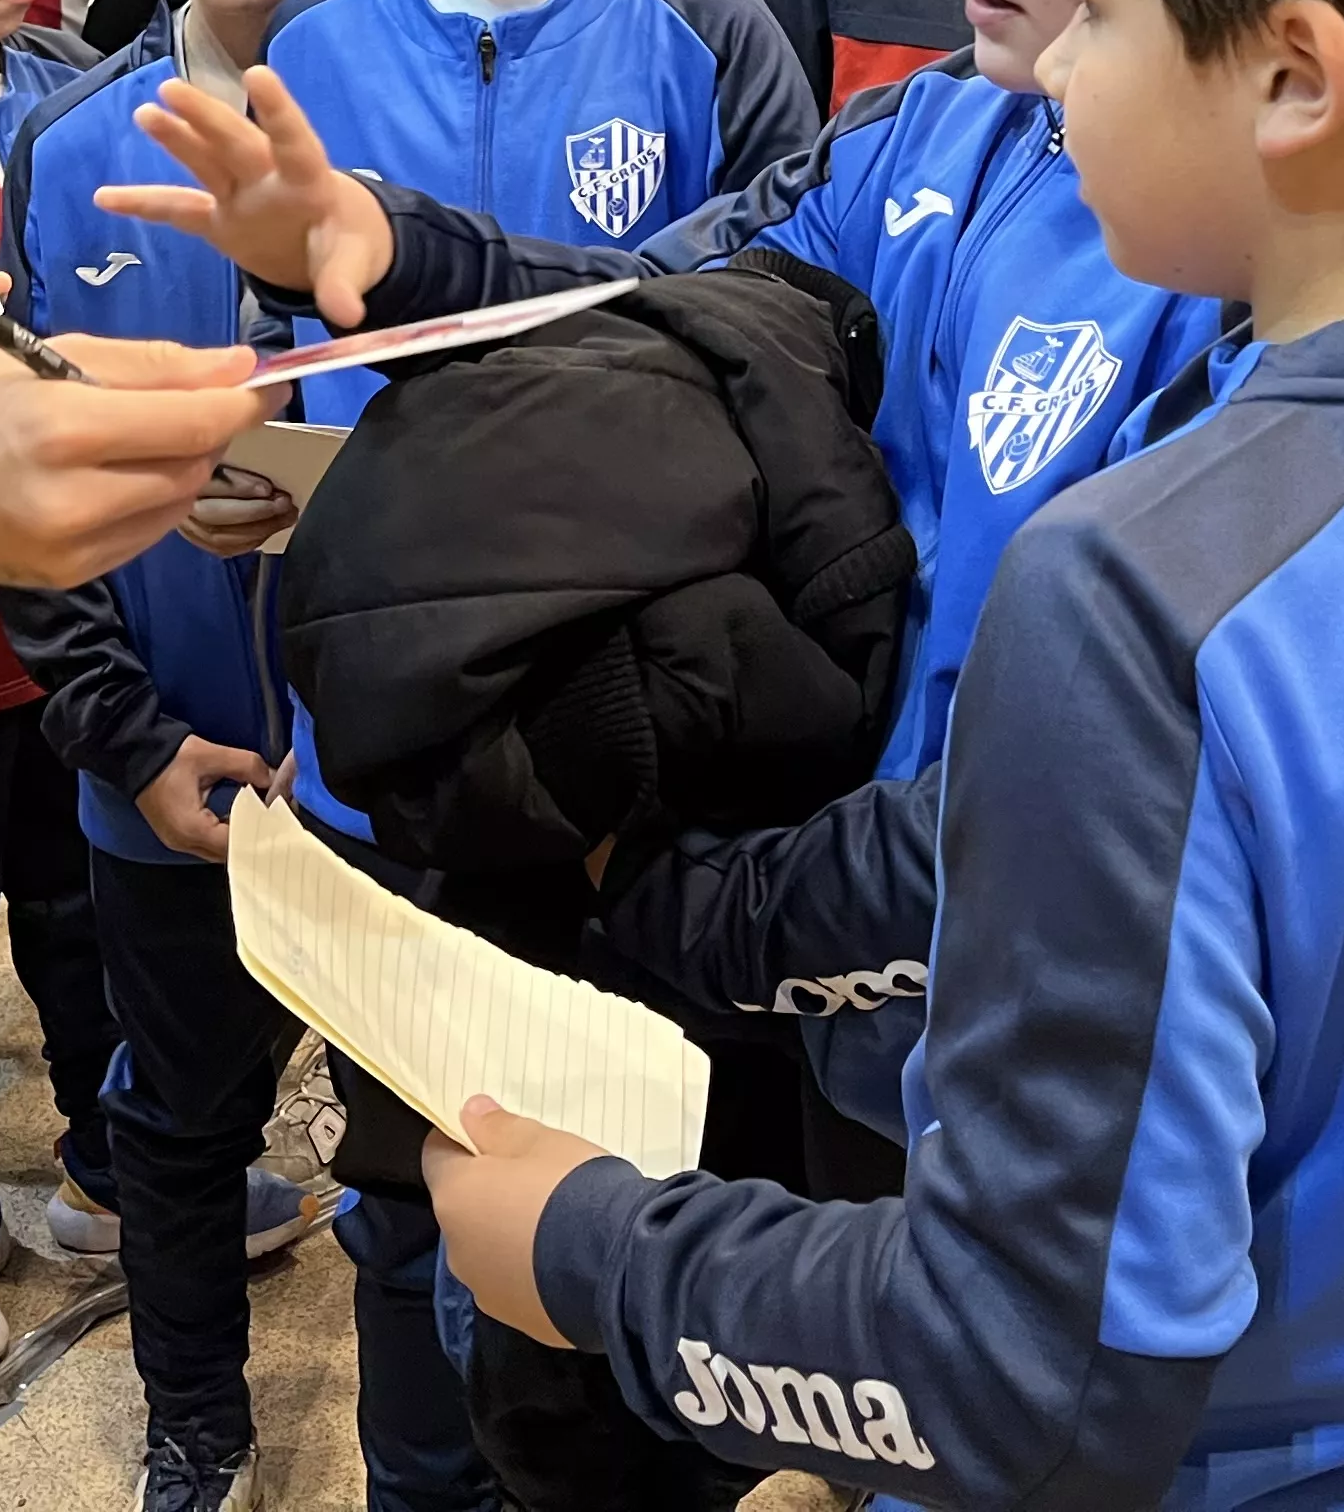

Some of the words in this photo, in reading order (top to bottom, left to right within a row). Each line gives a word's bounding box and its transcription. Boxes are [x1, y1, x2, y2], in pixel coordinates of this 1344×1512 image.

[577, 179, 608, 198] C.F.
[609, 147, 657, 184] GRAUS
[982, 395, 1026, 413] C.F.
[1034, 372, 1096, 413] GRAUS
[674, 1336, 936, 1471] Joma
